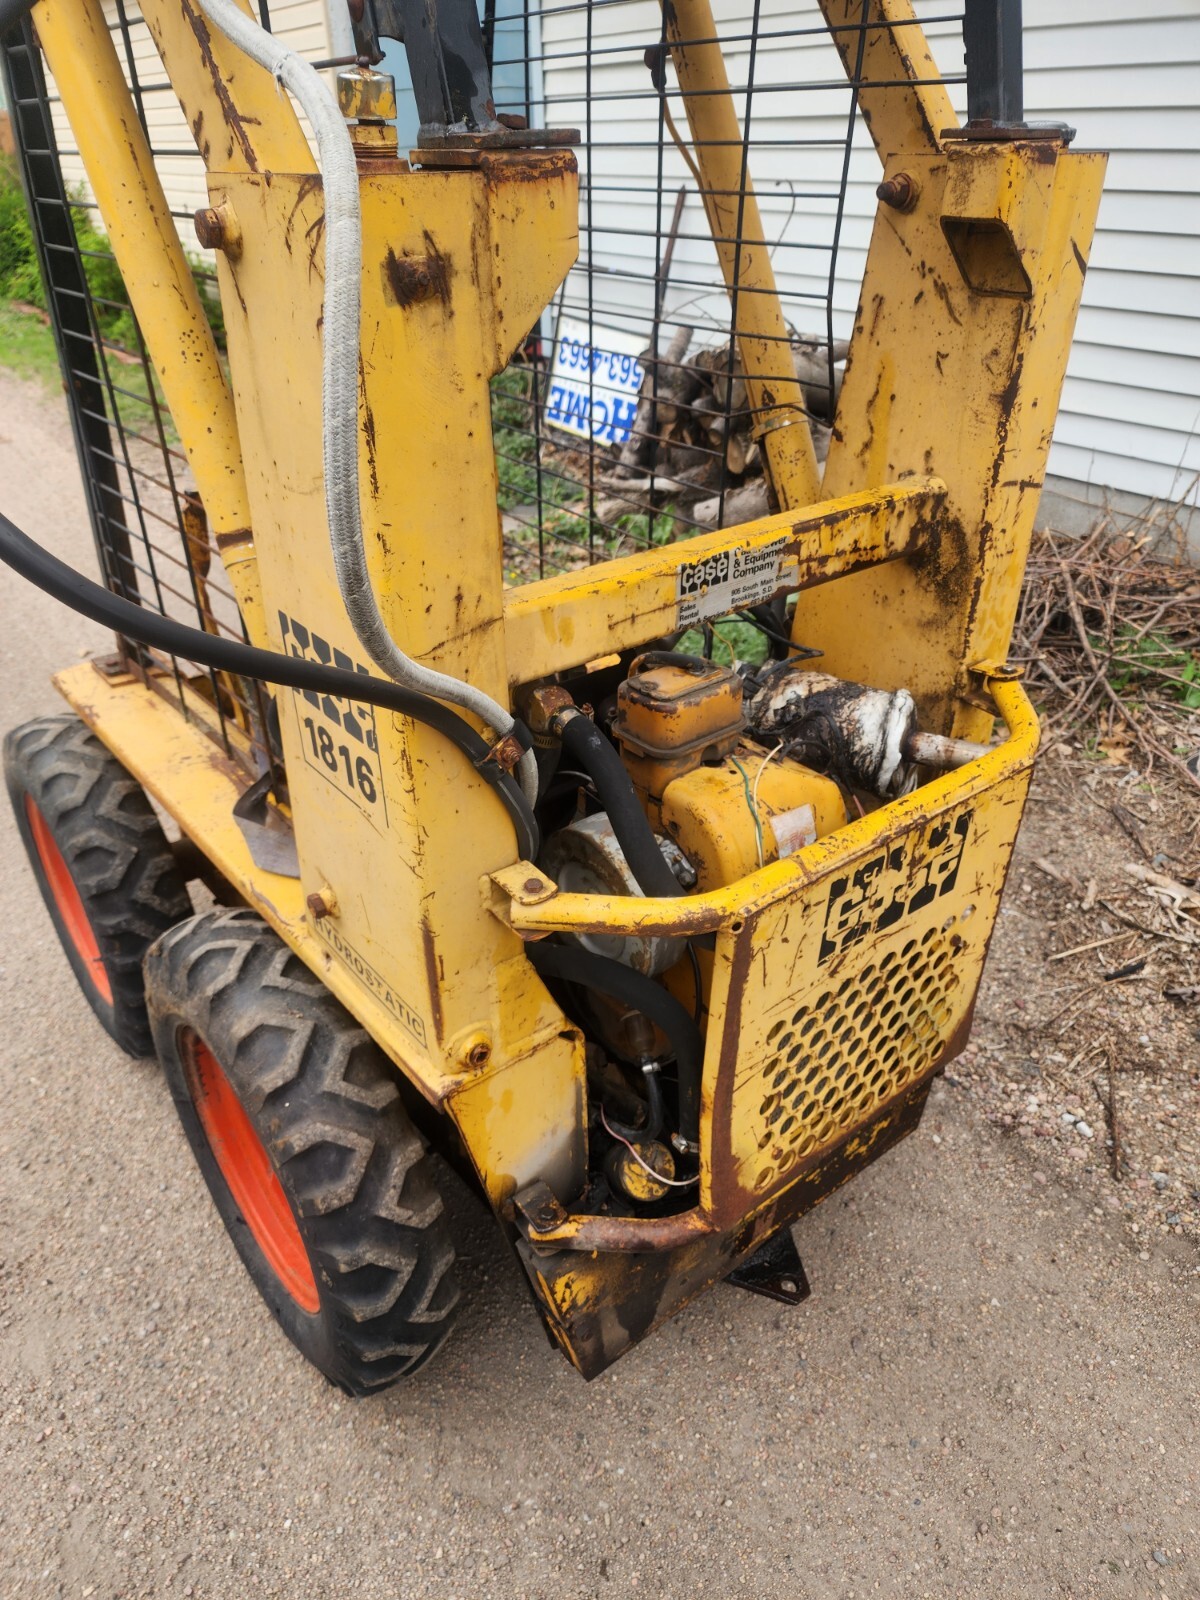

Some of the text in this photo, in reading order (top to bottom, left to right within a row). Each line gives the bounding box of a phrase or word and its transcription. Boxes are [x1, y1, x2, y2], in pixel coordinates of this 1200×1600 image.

[547, 385, 638, 444] HOME
[733, 560, 775, 579] Company
[734, 558, 741, 569] &
[742, 582, 758, 593] South
[760, 577, 774, 586] Main
[775, 572, 792, 582] Street
[680, 603, 697, 613] Sales
[680, 610, 699, 622] Rental
[303, 717, 377, 804] 1816
[315, 917, 422, 1036] HYDROSTATIC
